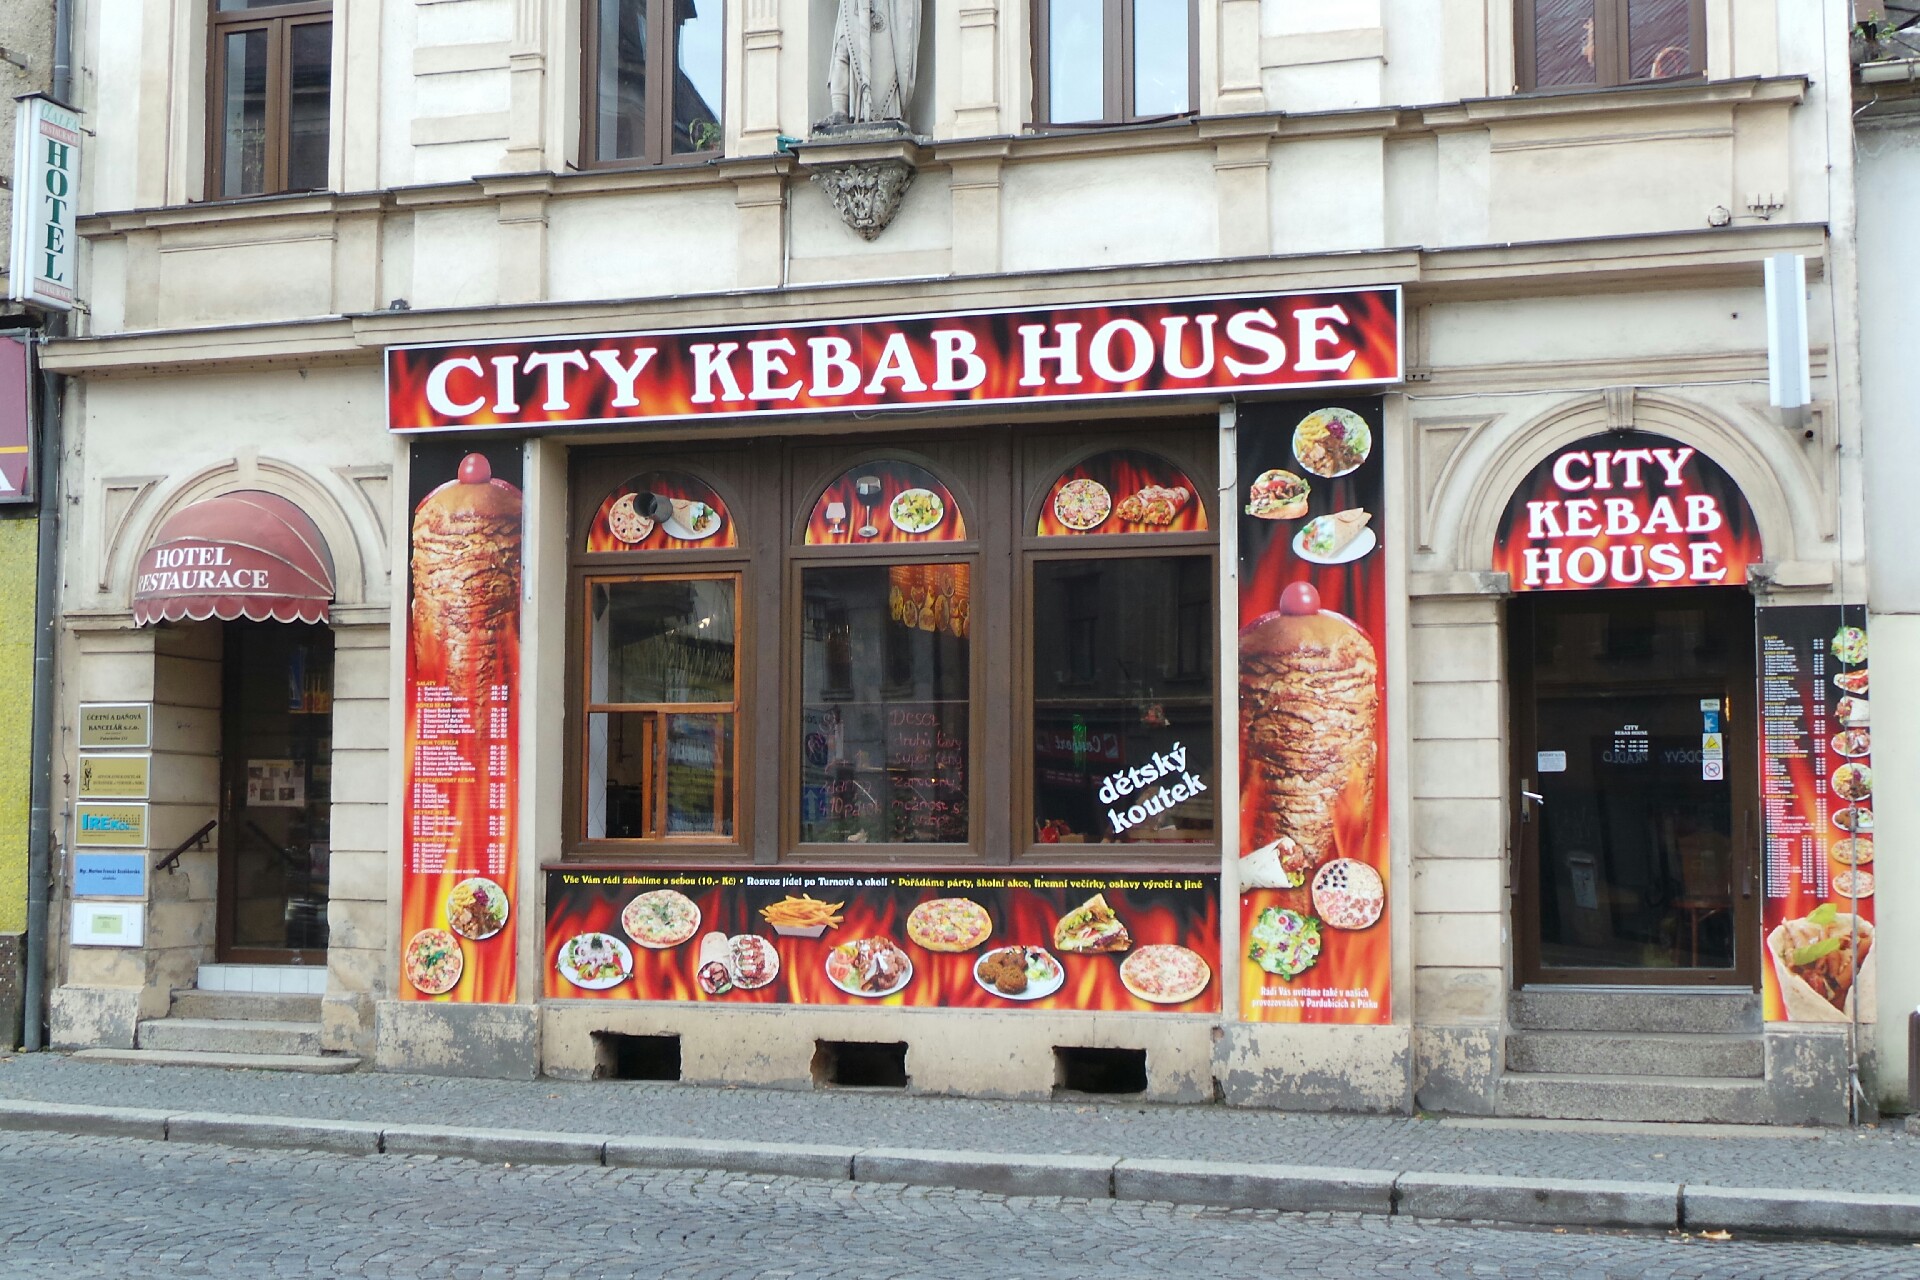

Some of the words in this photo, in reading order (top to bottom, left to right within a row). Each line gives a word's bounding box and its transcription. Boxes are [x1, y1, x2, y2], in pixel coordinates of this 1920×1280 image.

[44, 138, 69, 282] HOTEL
[425, 346, 657, 417] CITY
[690, 329, 987, 404] KEBAB
[1018, 304, 1356, 386] HOUSE
[1553, 448, 1693, 490] CITY
[1526, 495, 1722, 538] KEBAB
[155, 547, 232, 568] HOTEL
[1522, 541, 1727, 585] HOUSE
[137, 569, 269, 593] RESTAURACE
[1098, 741, 1187, 805] dětský
[1107, 771, 1208, 834] koutek
[562, 874, 579, 884] Vše
[581, 874, 600, 884] Vám
[603, 874, 620, 884] rádi
[622, 874, 661, 885] zabalíme
[670, 876, 696, 886] sebou
[722, 876, 736, 886] Kč)
[747, 876, 780, 886] Rozvoz
[804, 879, 816, 888] po
[818, 876, 854, 886] Turnově
[865, 876, 888, 886] okolí
[898, 877, 945, 887] Pořádáme
[947, 878, 974, 890] párty,
[976, 878, 1005, 888] školní
[1007, 879, 1032, 890] akce,
[1034, 878, 1068, 888] firemní
[1070, 878, 1106, 890] večírky,
[1109, 880, 1140, 890] oslavy
[1142, 879, 1173, 890] výročí
[1184, 878, 1203, 890] jiné
[1251, 998, 1298, 1008] provozovnách
[1306, 998, 1348, 1008] Pardubicích
[1358, 1000, 1378, 1009] Písku
[1260, 986, 1277, 996] Rádi
[1279, 986, 1291, 996] Vás
[1293, 987, 1321, 997] uvítáme
[1322, 988, 1338, 998] také
[1345, 988, 1369, 998] našich
